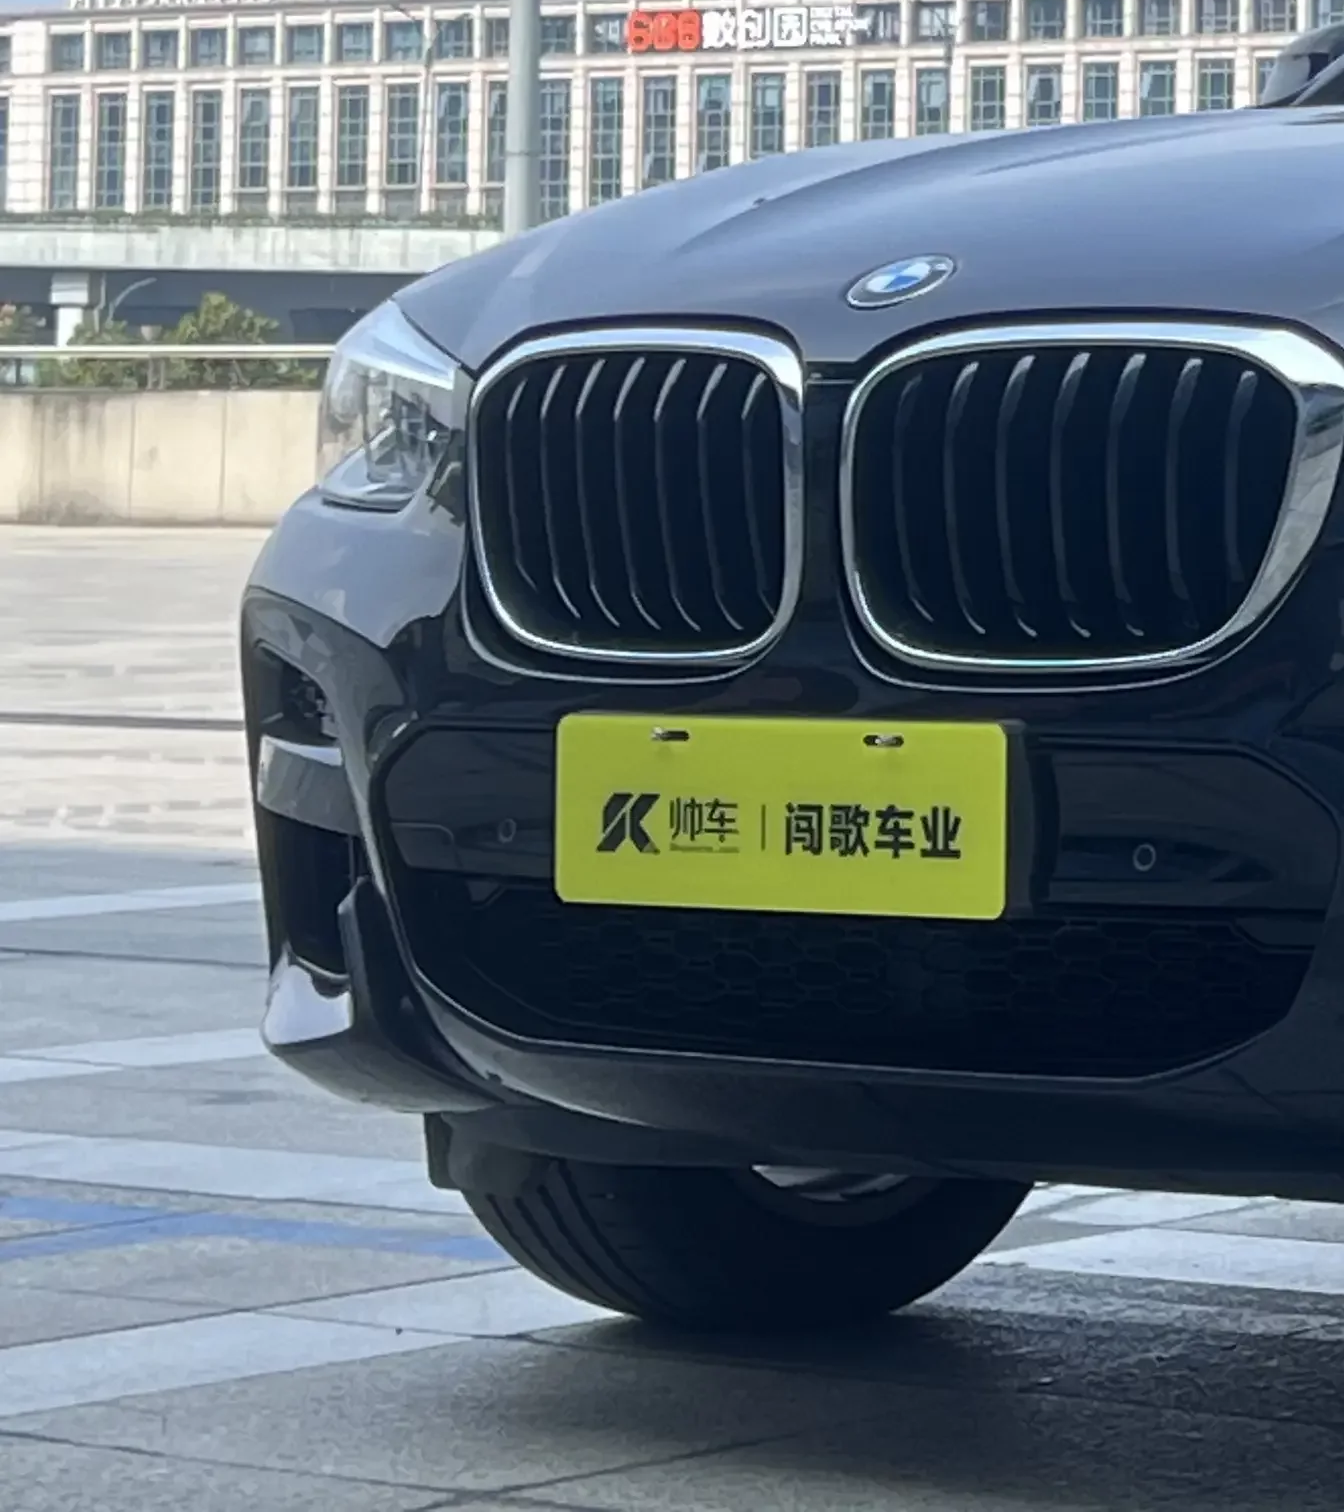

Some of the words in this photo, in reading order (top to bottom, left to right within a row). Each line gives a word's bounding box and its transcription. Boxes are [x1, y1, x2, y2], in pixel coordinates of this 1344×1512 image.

[669, 796, 740, 843] 帅车
[785, 802, 961, 859] 闯歌车业
